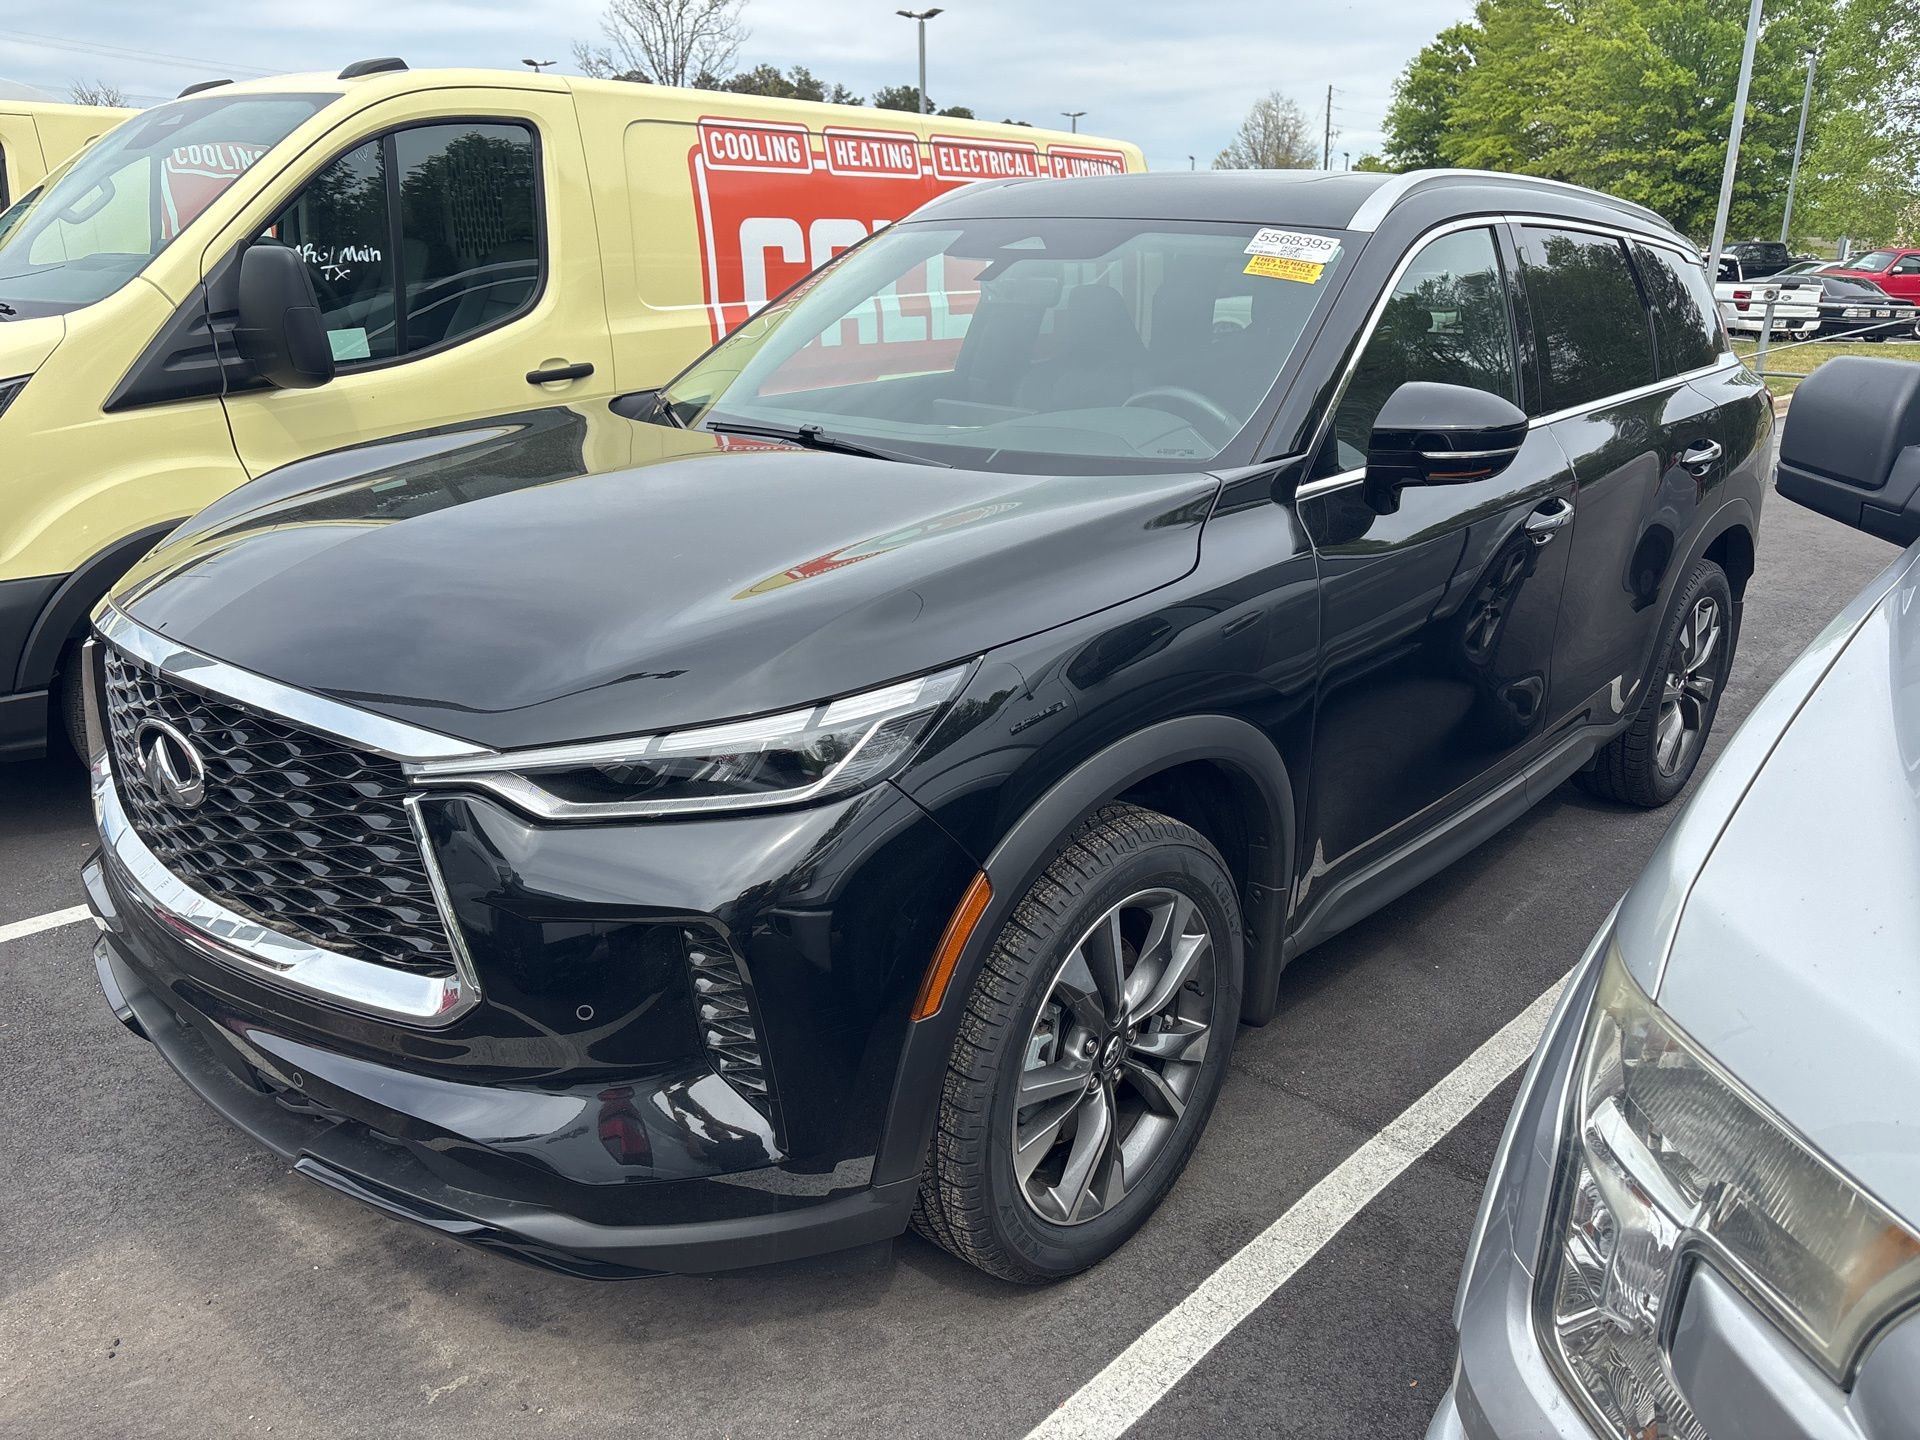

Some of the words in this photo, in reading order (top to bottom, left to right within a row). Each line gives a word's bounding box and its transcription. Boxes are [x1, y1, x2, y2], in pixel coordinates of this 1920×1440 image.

[709, 130, 800, 164] COOLING
[833, 139, 913, 170] HEATING
[938, 147, 1034, 178] ELECTRICAL
[1258, 232, 1334, 251] 5568395
[339, 244, 382, 264] Main
[1279, 259, 1319, 270] VEHICLE
[1291, 266, 1313, 274] SALE
